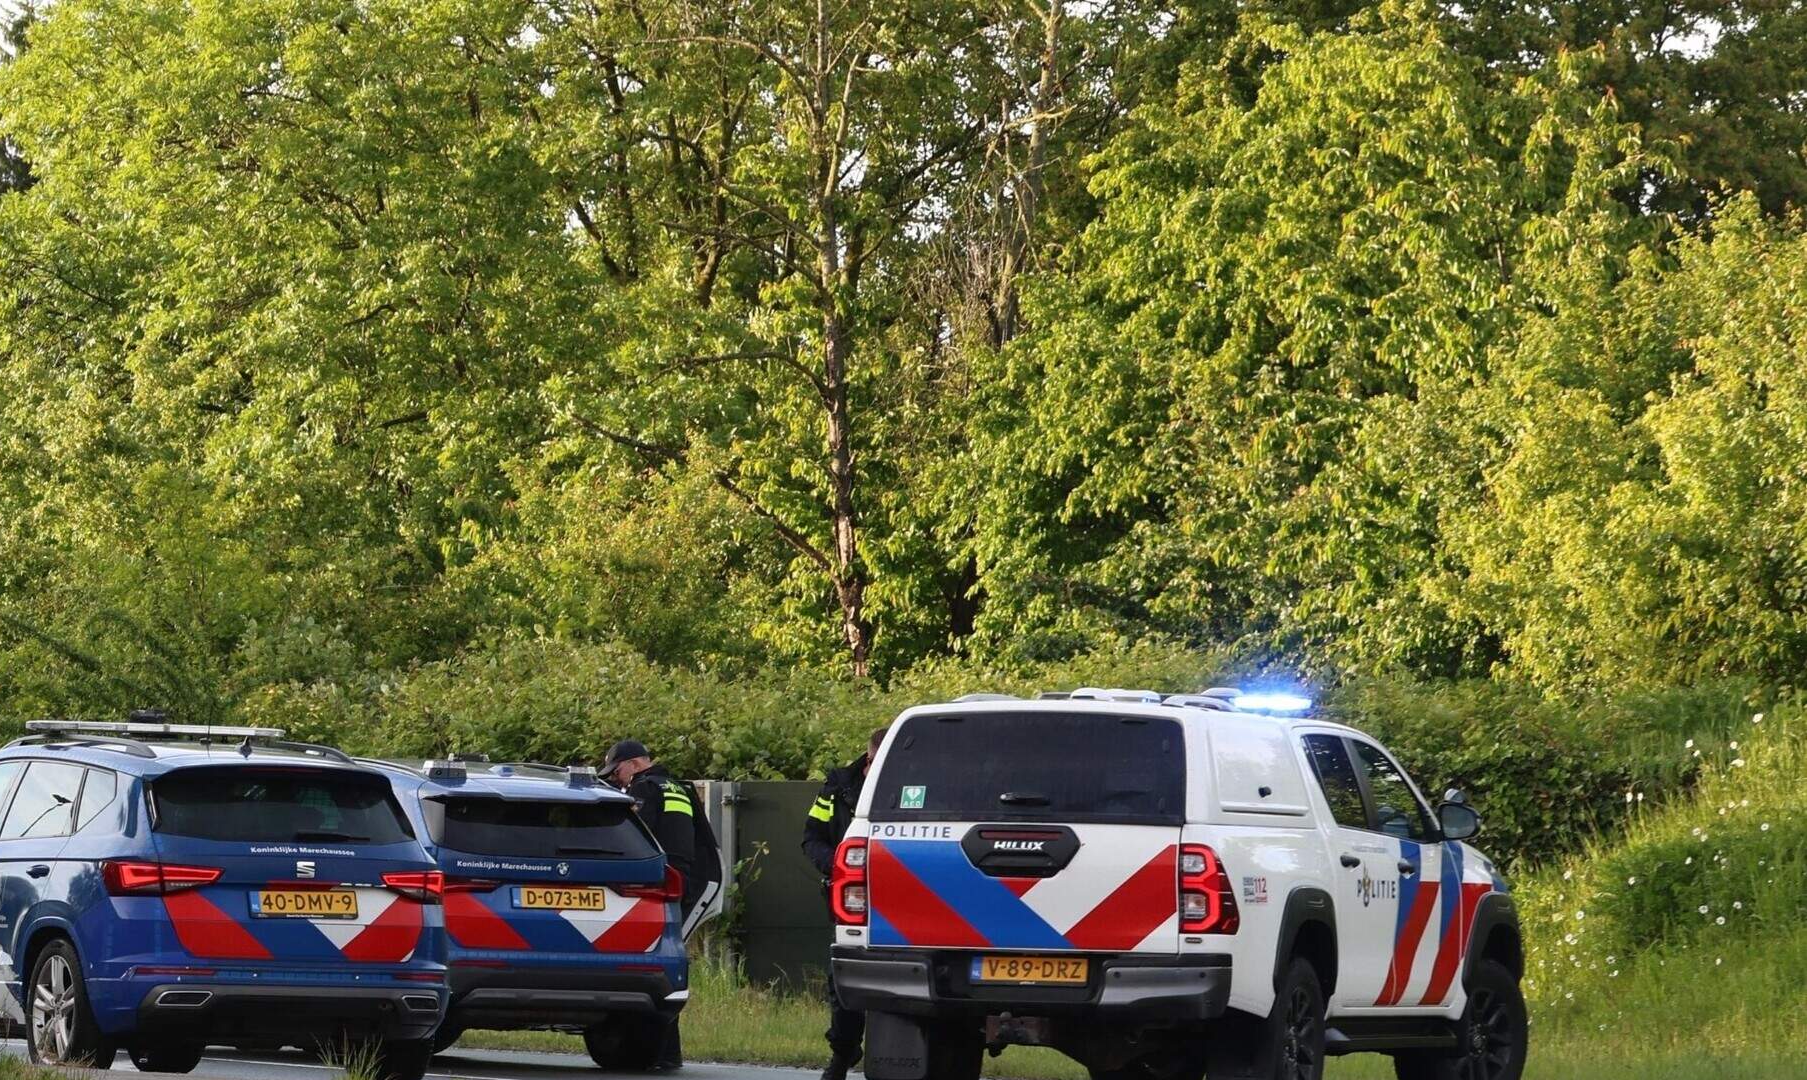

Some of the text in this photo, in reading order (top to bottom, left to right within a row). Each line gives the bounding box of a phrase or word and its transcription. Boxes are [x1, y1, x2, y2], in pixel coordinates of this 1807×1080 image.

[871, 825, 952, 838] POLITIE
[250, 846, 355, 857] Koninklijke Marechaussee
[994, 840, 1045, 851] HILUX
[456, 860, 552, 872] Koninklijke Marechaussee
[262, 894, 353, 911] 40-DMV-9
[526, 890, 601, 907] D-073-MF
[988, 959, 1083, 979] V-89-DRZ
